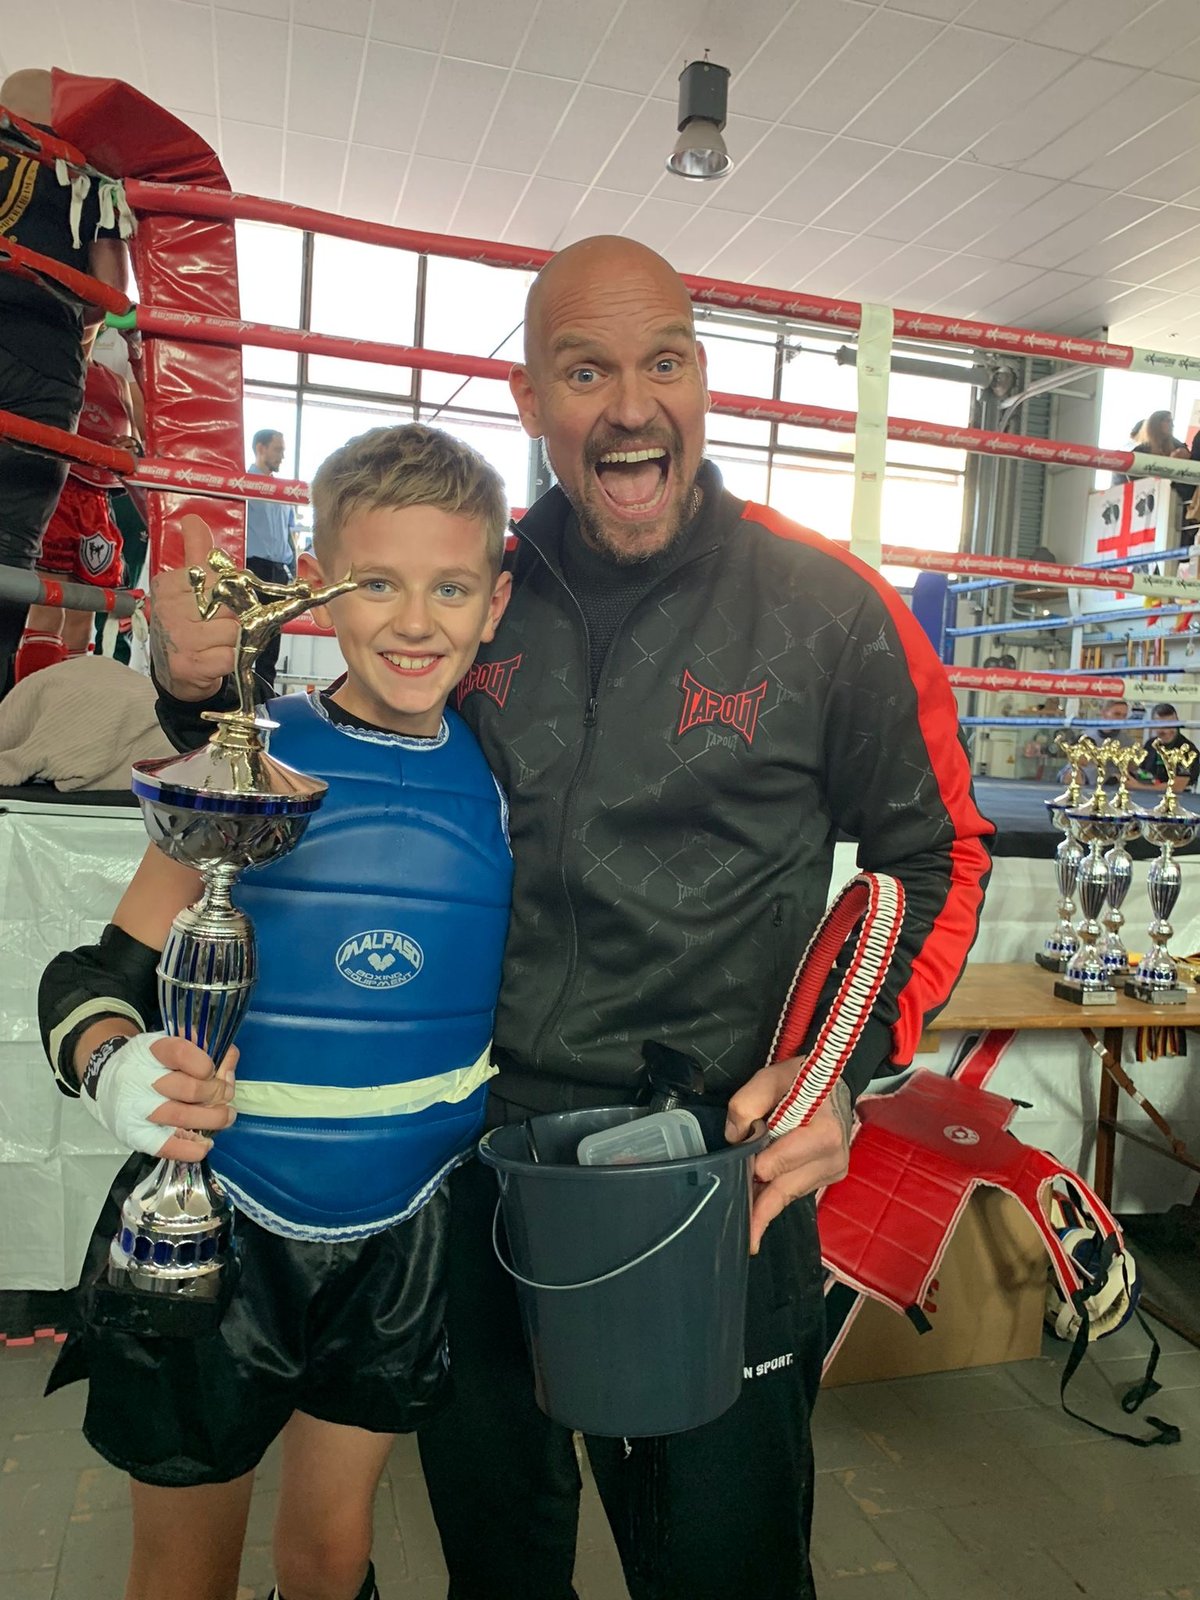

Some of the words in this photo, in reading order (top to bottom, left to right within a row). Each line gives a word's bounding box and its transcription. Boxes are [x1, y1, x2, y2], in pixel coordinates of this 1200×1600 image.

[678, 668, 768, 745] TAPOUT
[705, 728, 739, 752] TAPOUT
[338, 932, 421, 970] MALPASO
[343, 967, 412, 987] EQUIPMENT
